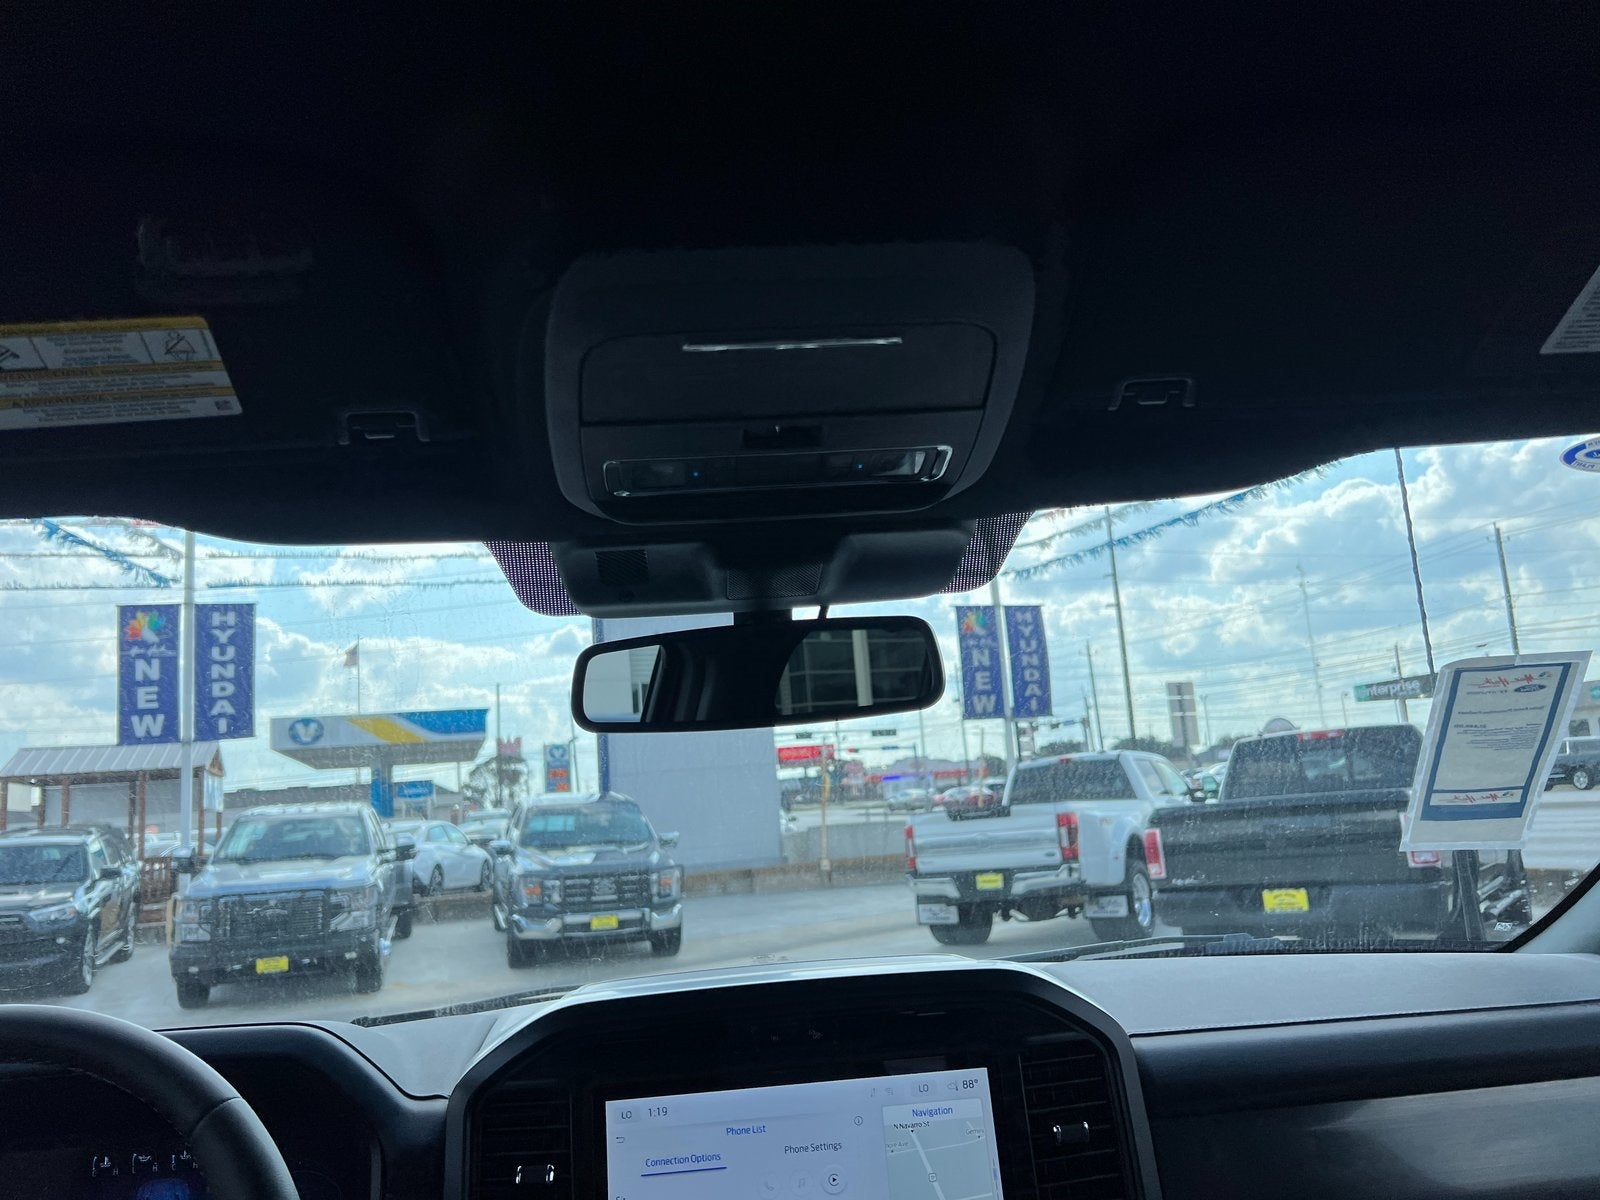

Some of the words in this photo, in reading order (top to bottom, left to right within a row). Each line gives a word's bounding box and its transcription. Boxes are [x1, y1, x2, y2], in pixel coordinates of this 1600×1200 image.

[1015, 610, 1042, 712] HYUNDAI
[210, 611, 236, 734] HYUNDAI
[971, 648, 997, 714] NEW
[131, 658, 165, 738] NEW
[918, 1083, 929, 1093] LO
[962, 1078, 979, 1090] 88°
[621, 1110, 633, 1120] LO
[648, 1106, 668, 1118] 1:19
[912, 1106, 953, 1118] Navigation
[726, 1126, 751, 1136] Phone
[752, 1125, 766, 1134] List
[784, 1143, 809, 1155] Phone
[811, 1141, 842, 1153] Settings
[645, 1153, 690, 1168] Connection
[690, 1152, 721, 1165] Options
